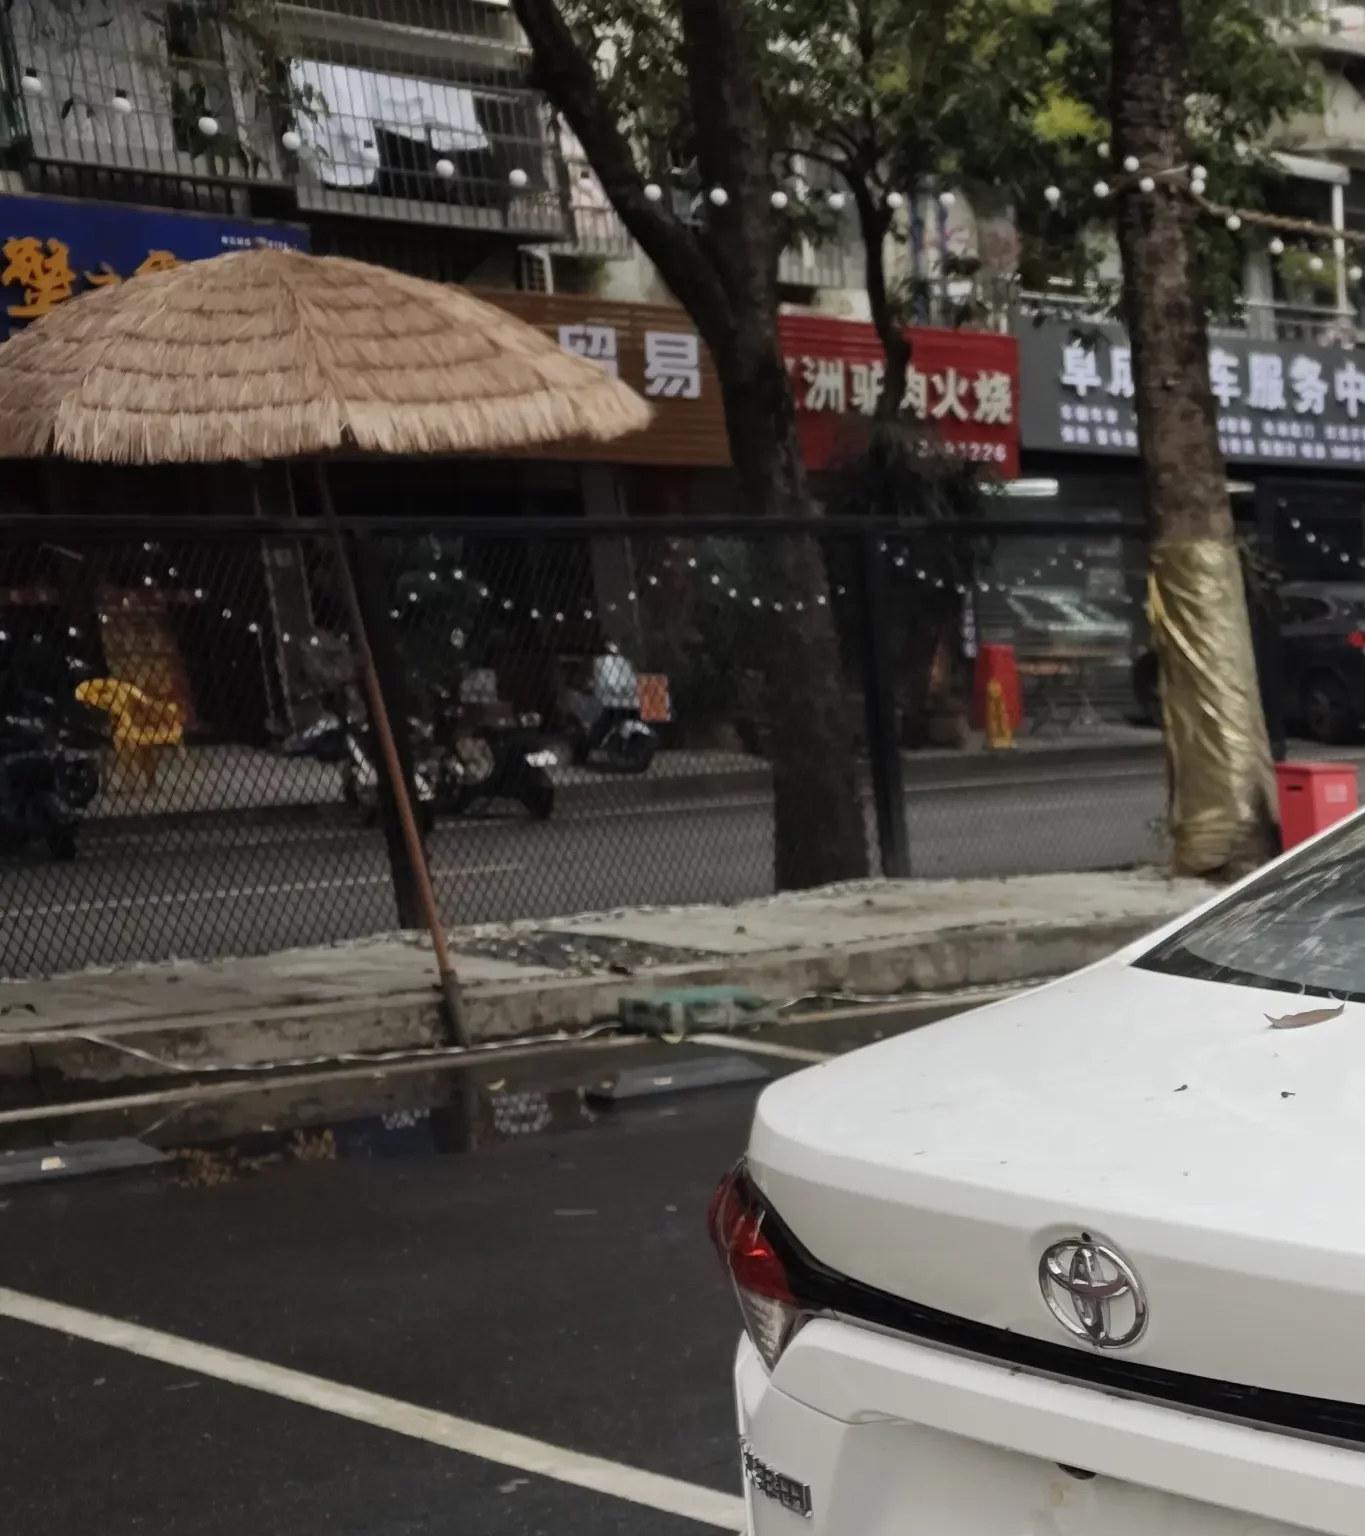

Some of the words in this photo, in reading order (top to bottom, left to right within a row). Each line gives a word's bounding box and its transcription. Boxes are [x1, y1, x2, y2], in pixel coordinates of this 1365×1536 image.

[784, 355, 1013, 424] 洲驴肉火烧
